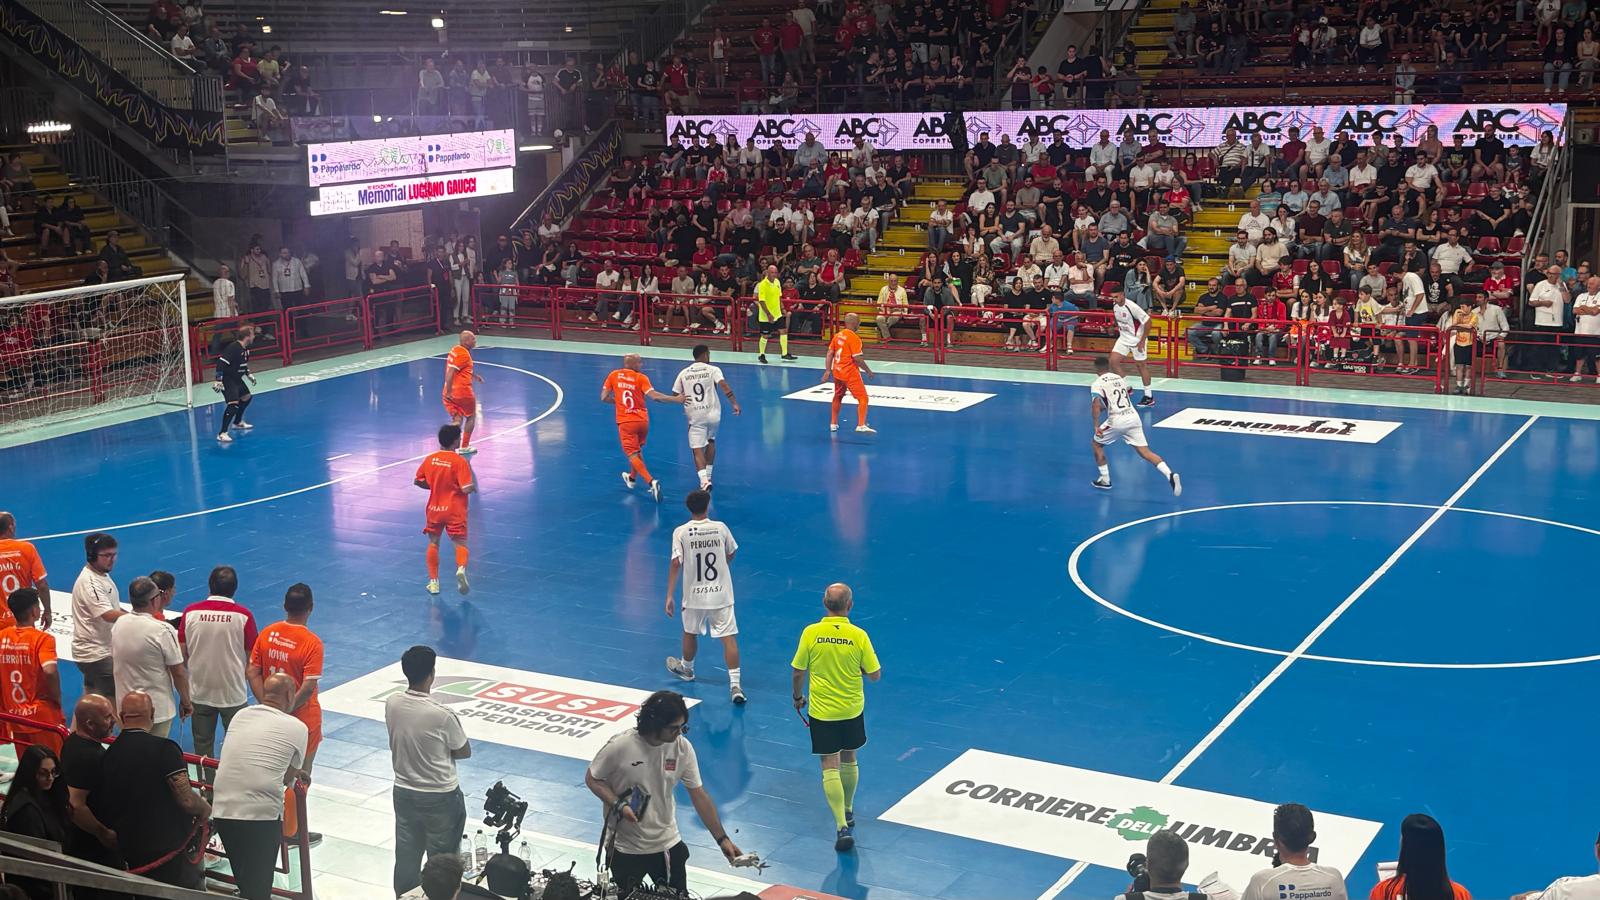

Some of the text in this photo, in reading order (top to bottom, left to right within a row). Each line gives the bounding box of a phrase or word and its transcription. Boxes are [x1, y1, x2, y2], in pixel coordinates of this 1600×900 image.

[672, 119, 713, 138] ABC
[752, 119, 796, 138] ABC
[835, 118, 880, 138] ABC
[913, 117, 946, 137] AB
[1016, 115, 1070, 136] ABC
[1116, 113, 1173, 135] ABC
[1221, 111, 1282, 134] ABC
[1333, 110, 1398, 133] ABC
[1452, 109, 1521, 133] ABC
[435, 152, 471, 164] Pappalardo
[358, 185, 407, 206] Memorial
[408, 180, 445, 200] LUCIANO
[446, 177, 477, 195] GAUCCI
[622, 390, 634, 409] 6
[693, 383, 705, 402] 9
[690, 539, 721, 549] PERUGINI
[695, 552, 718, 582] 18
[199, 614, 232, 623] MISTER
[816, 637, 854, 646] DIADORA
[10, 670, 27, 704] 8
[490, 686, 632, 720] SUSA
[456, 709, 592, 739] SPEDIZIONI
[475, 701, 606, 730] TRASPORTI
[945, 780, 1117, 825] CORRIERE
[1289, 890, 1332, 900] Pappalardo
